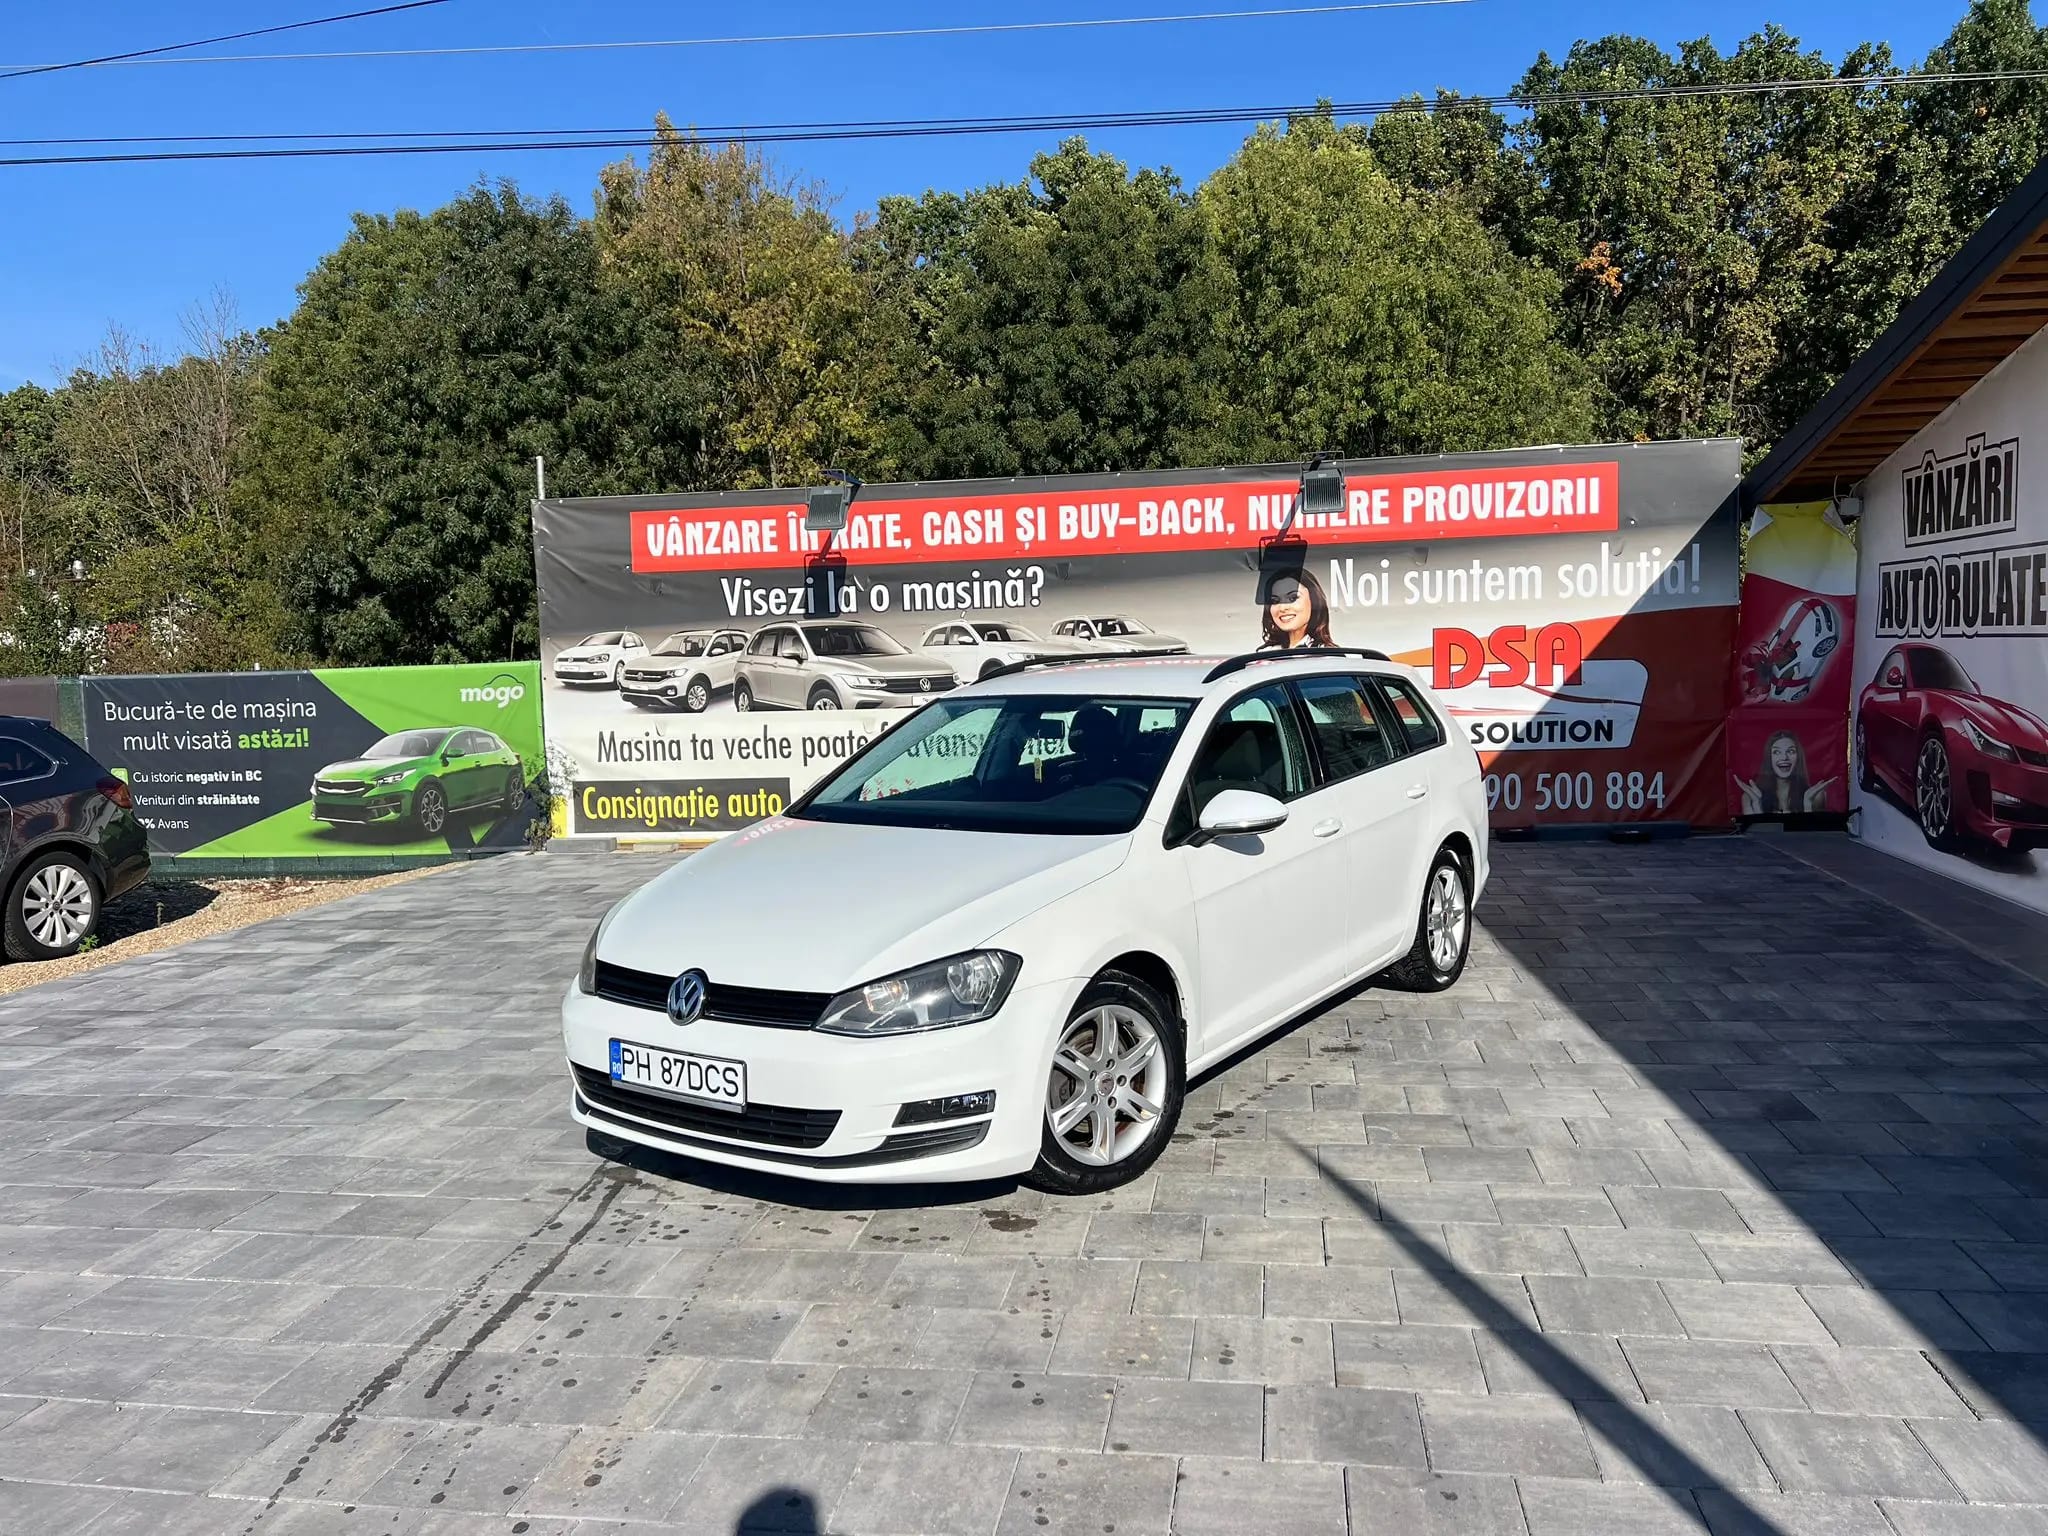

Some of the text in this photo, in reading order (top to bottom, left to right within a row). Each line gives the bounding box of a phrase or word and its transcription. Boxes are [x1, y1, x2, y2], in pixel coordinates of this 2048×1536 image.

[1906, 444, 2014, 538] VÂNZĂRI
[646, 516, 779, 557] VÂNZARE
[922, 508, 1004, 547] CASH
[1015, 506, 1047, 550] ȘI
[1059, 497, 1235, 541] BUY-BACK,
[1403, 477, 1600, 523] PROVIZORII
[720, 575, 815, 617] Visezi
[827, 570, 859, 614] la
[869, 583, 891, 612] o
[1330, 558, 1390, 608] Noi
[1403, 559, 1543, 605] suntem
[1879, 552, 2047, 630] AUTO RULATE
[1431, 621, 1583, 690] DSA
[104, 698, 317, 722] Bucură-te de mașina
[460, 685, 525, 709] mogo
[123, 728, 310, 751] mult visată astăzi!
[691, 733, 714, 761] ta
[722, 724, 792, 760] veche
[1470, 719, 1614, 745] SOLUTION
[133, 771, 148, 783] Cu
[151, 771, 184, 783] istoric
[186, 770, 229, 784] negativ
[246, 770, 262, 782] BC
[1535, 771, 1593, 810] 500
[1605, 771, 1666, 810] 884
[135, 794, 175, 806] Venituri
[178, 794, 195, 806] din
[582, 786, 782, 827] Consignație auto
[158, 818, 189, 829] Avans
[621, 1047, 739, 1098] PH 87DCS
